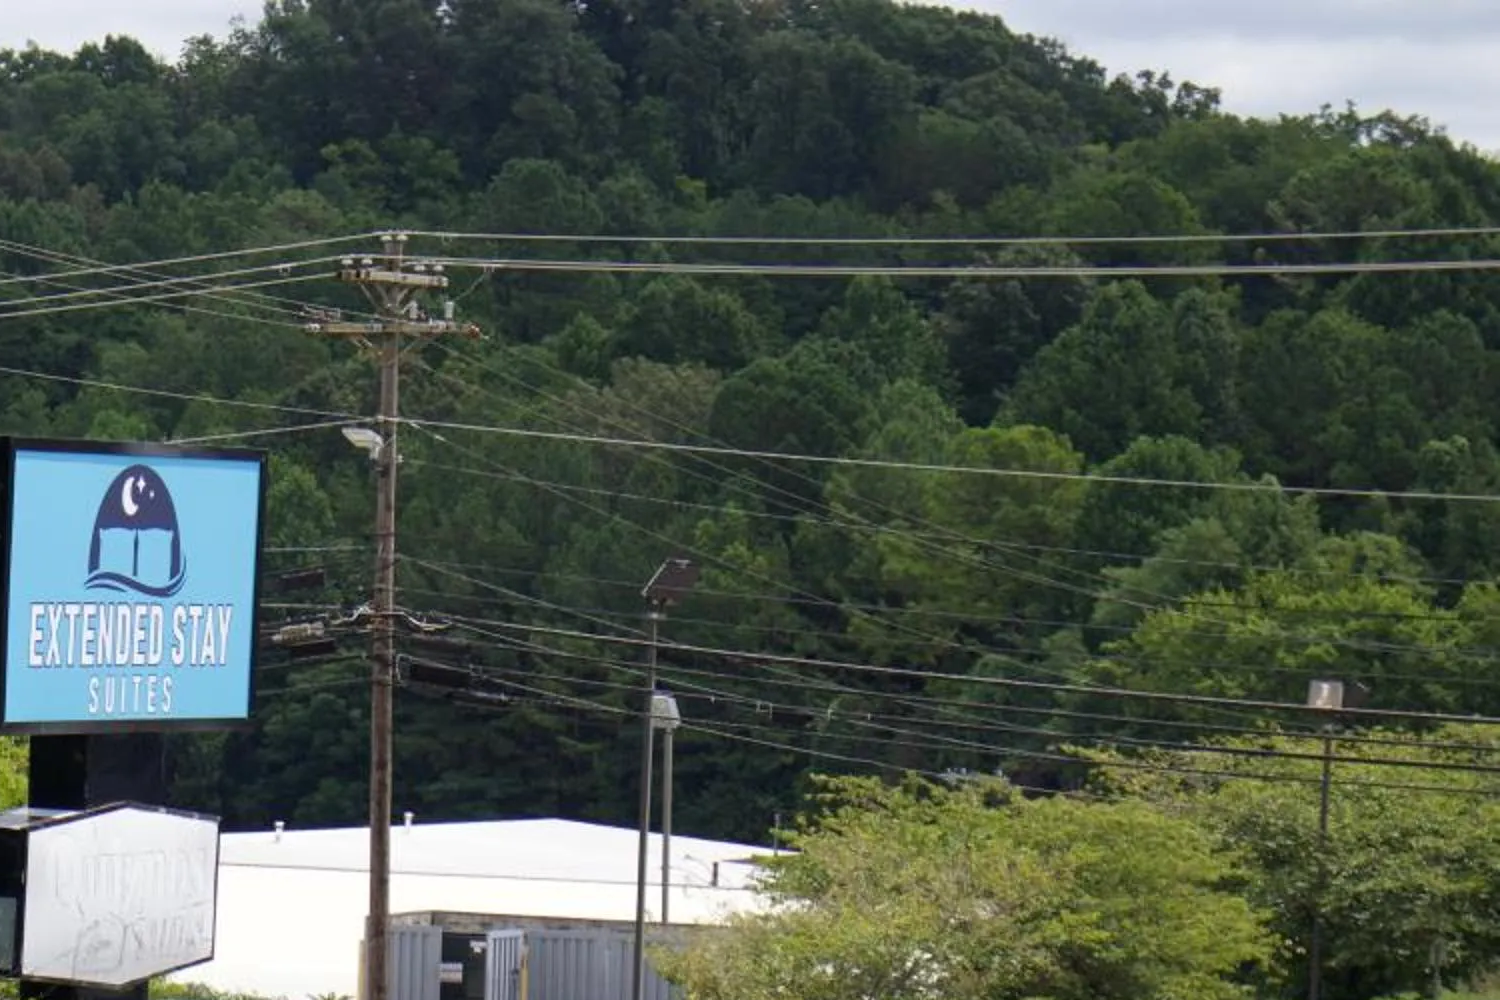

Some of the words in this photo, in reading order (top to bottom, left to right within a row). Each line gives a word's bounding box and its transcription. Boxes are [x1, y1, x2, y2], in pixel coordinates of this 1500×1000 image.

[28, 602, 163, 668] EXTENDED
[171, 604, 233, 666] STAY
[88, 675, 172, 714] SUITES
